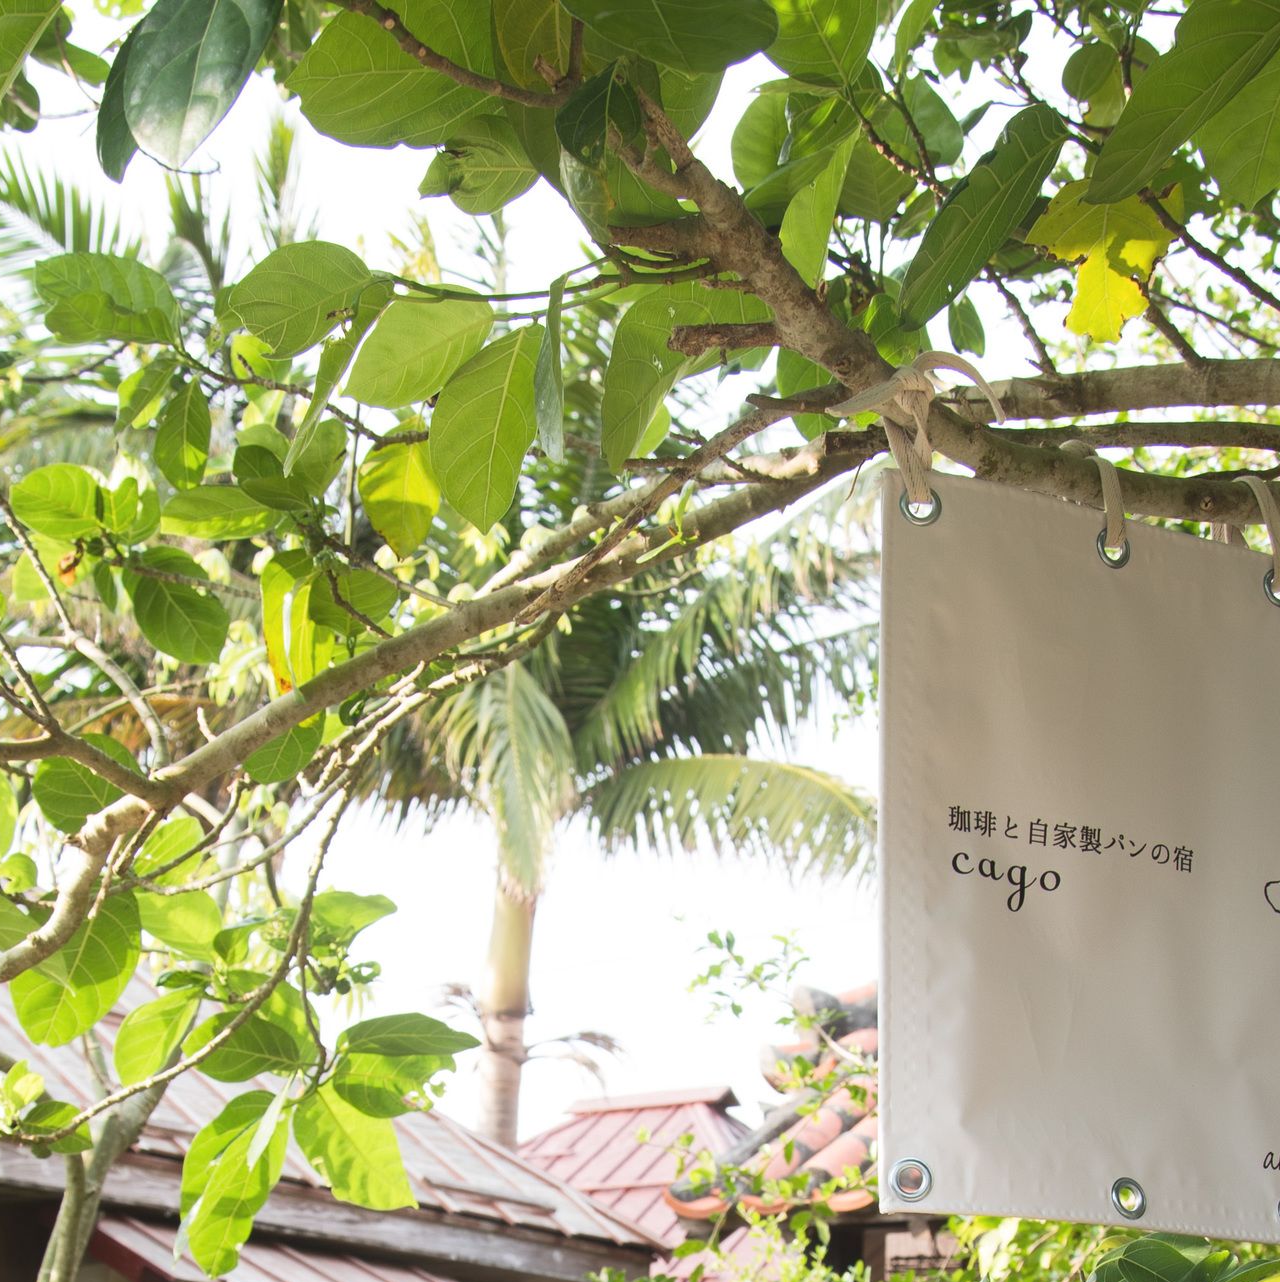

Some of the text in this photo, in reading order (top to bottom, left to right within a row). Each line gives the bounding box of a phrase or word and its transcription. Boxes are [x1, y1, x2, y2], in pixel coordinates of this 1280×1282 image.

[948, 805, 1194, 873] 珈琲と自家製パンの宿
[951, 852, 1061, 913] cago
